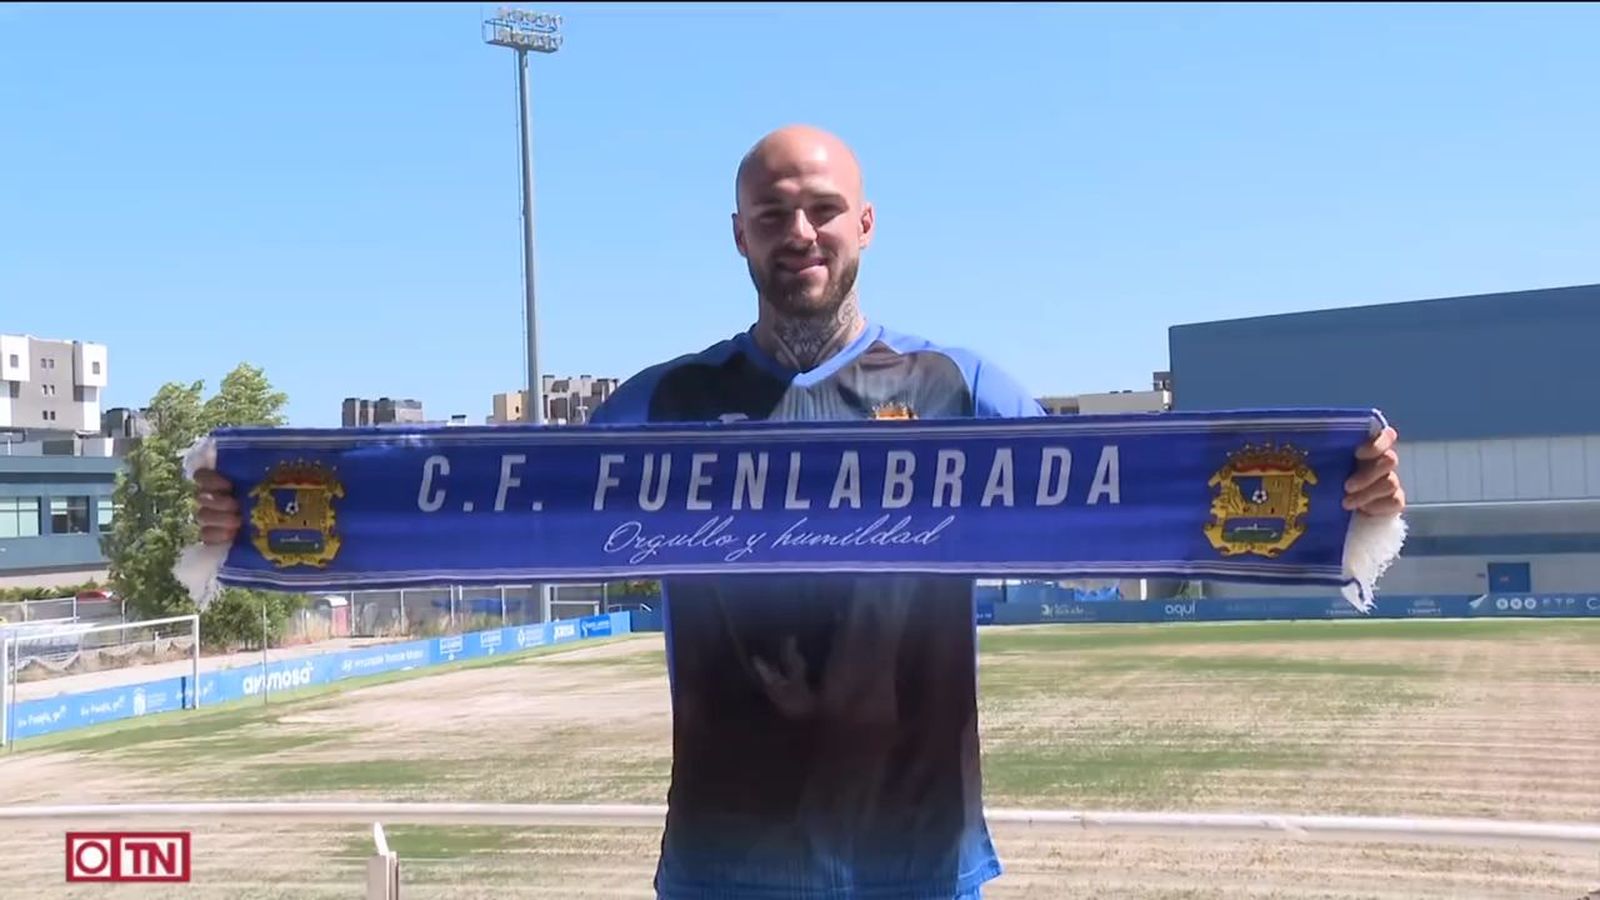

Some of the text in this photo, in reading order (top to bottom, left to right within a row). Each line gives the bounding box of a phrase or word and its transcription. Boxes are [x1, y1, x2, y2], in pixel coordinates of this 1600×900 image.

[593, 445, 1121, 512] FUENLABRADA
[603, 513, 956, 564] Orgullo y humildad
